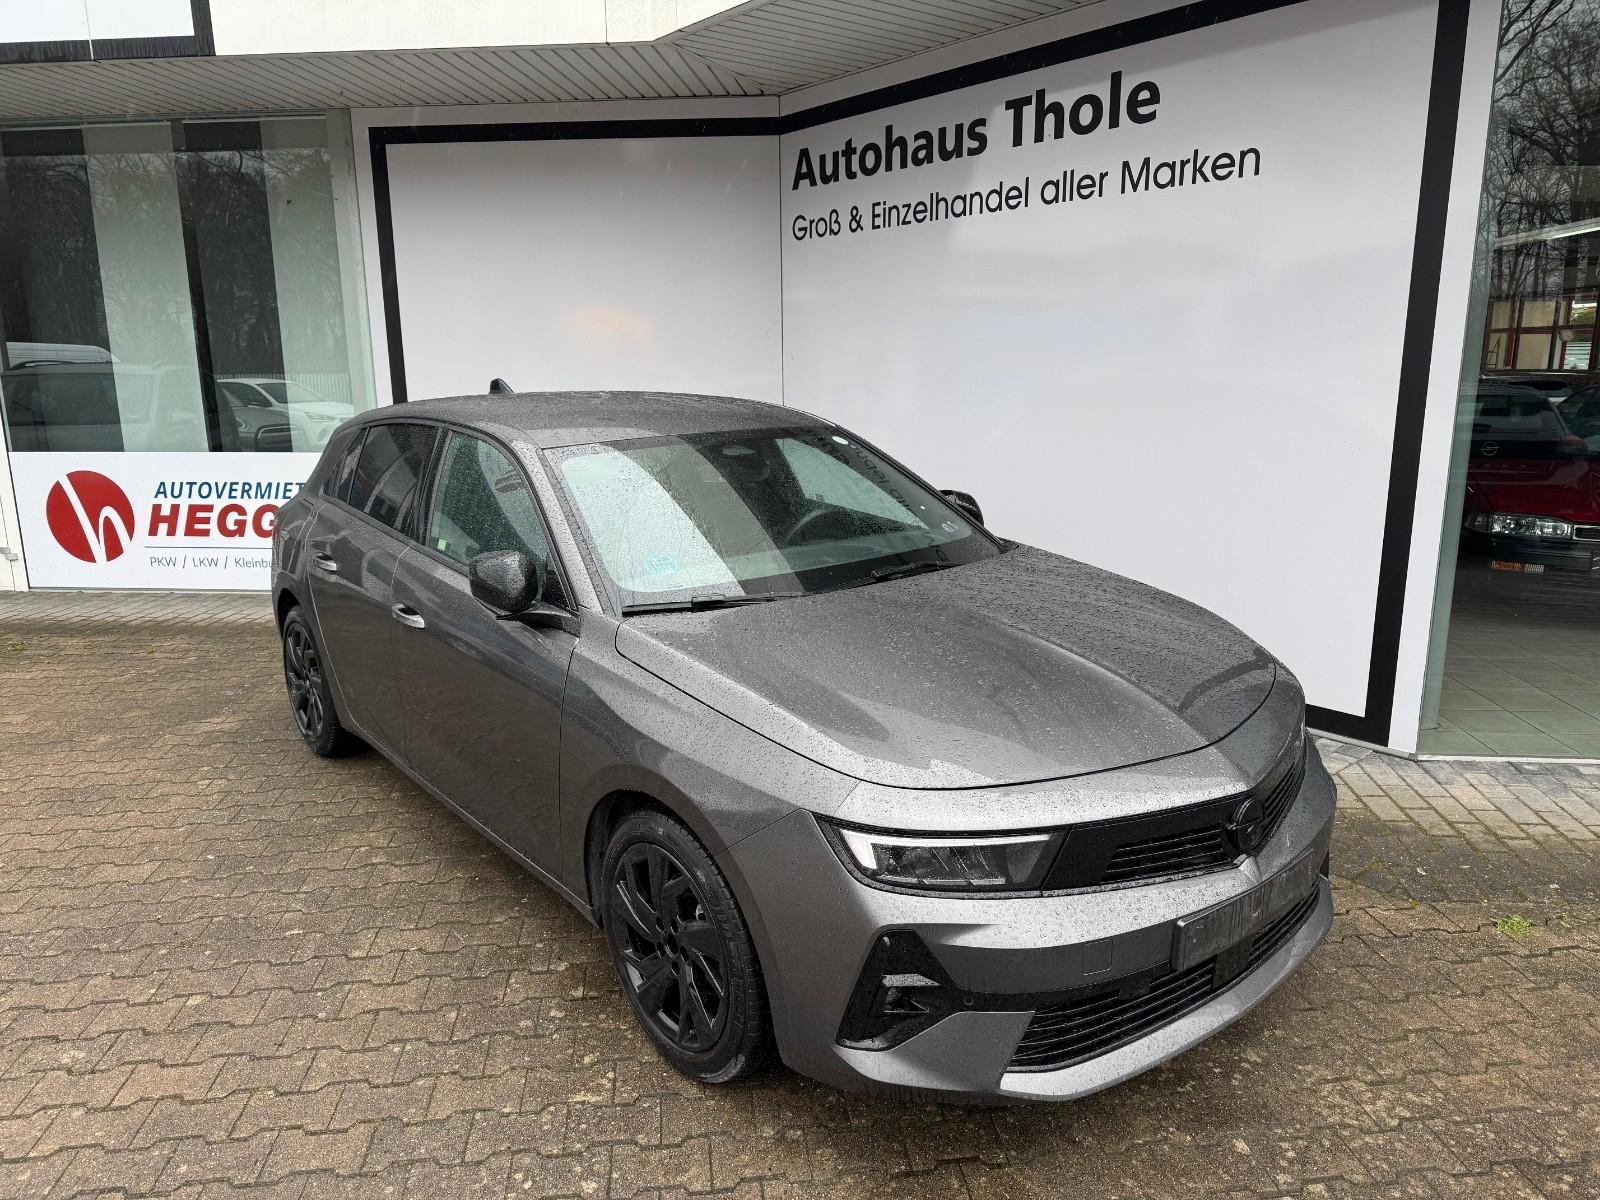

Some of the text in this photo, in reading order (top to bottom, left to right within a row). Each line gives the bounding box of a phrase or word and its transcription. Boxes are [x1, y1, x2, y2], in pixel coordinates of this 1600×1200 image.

[792, 70, 1161, 191] Autohaus Thole
[792, 147, 1261, 241] Groß & Einzelhandel aller Marken
[154, 481, 305, 499] AUTOVERMIET
[148, 503, 278, 538] HEGG
[150, 556, 177, 568] PKW
[192, 557, 219, 568] LKW
